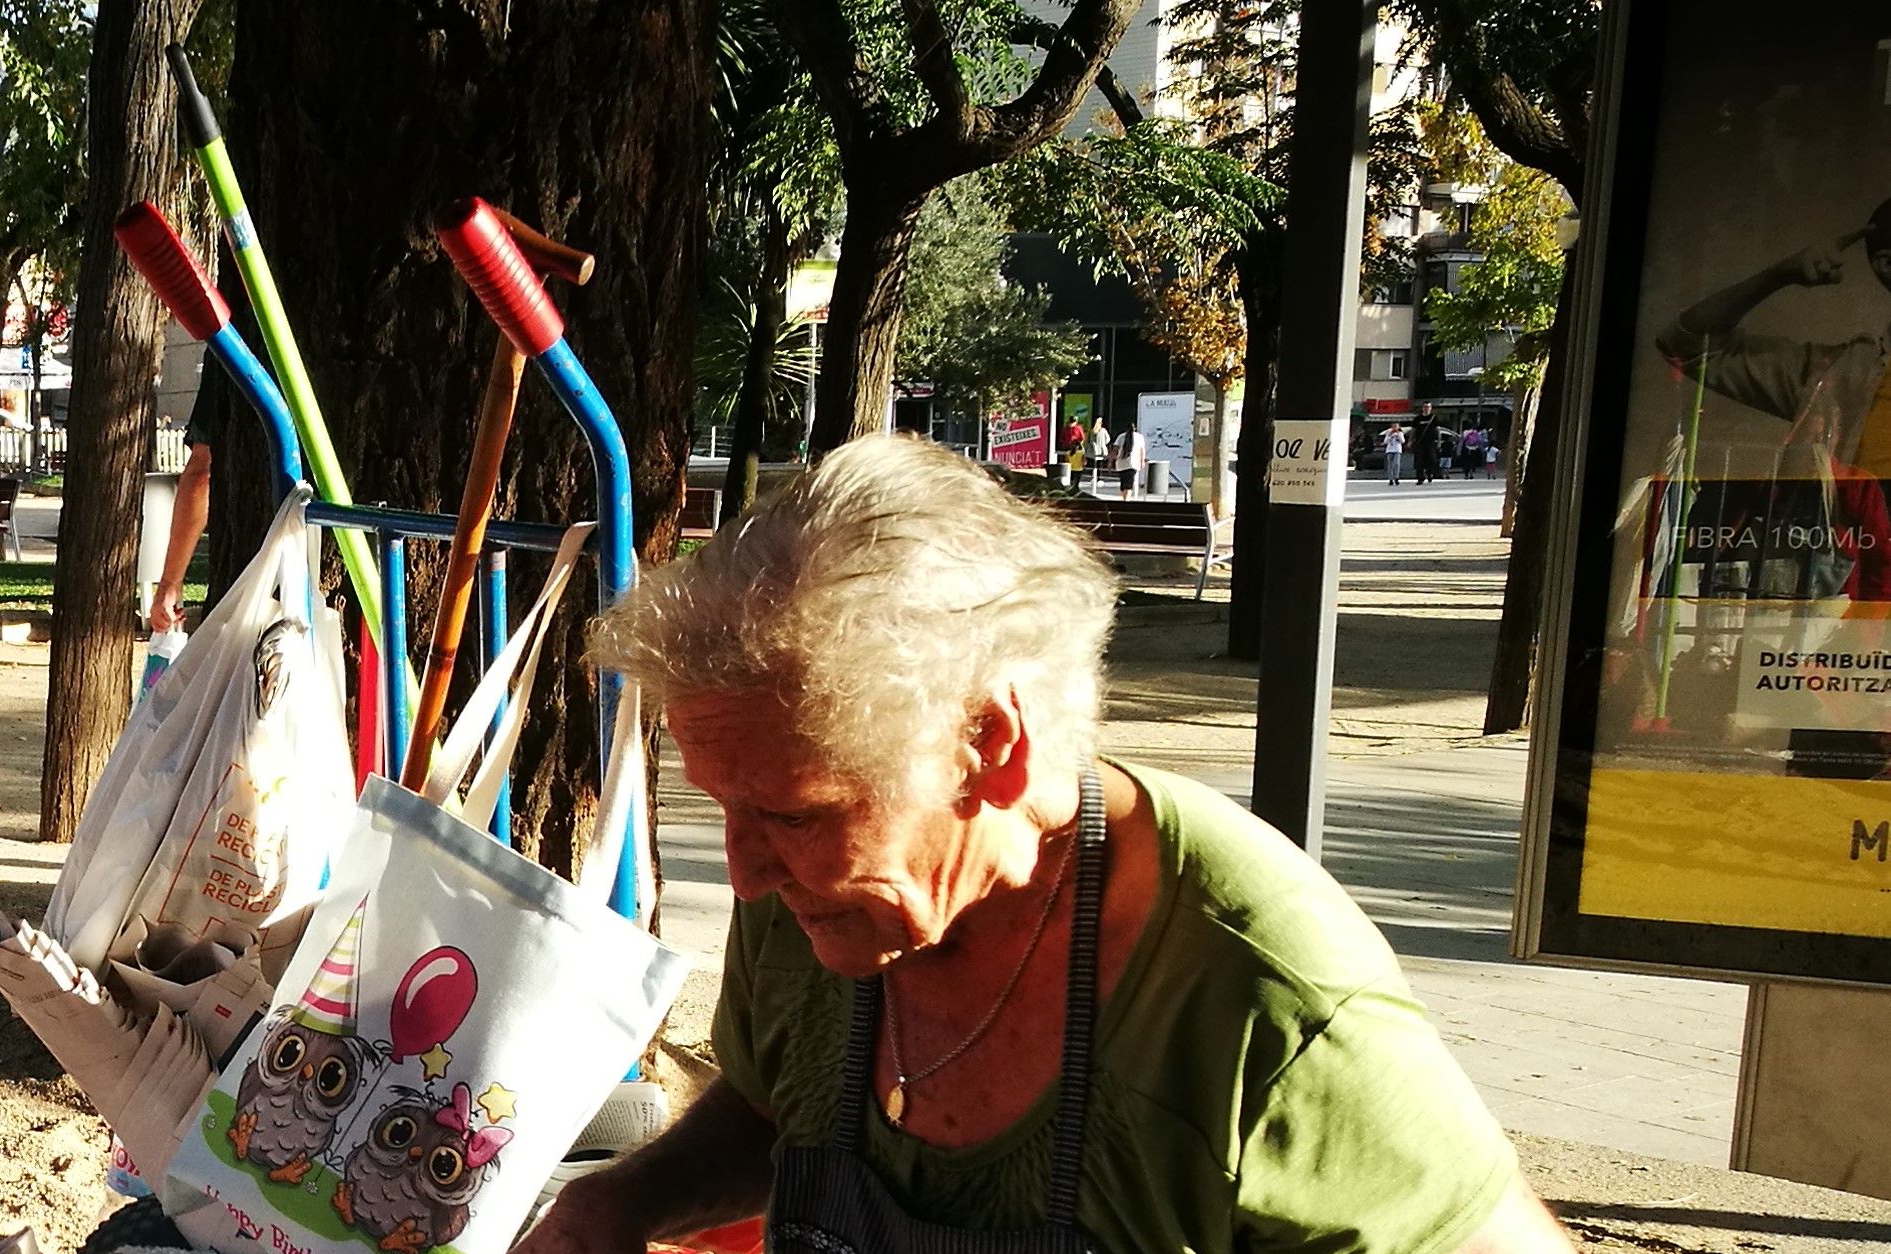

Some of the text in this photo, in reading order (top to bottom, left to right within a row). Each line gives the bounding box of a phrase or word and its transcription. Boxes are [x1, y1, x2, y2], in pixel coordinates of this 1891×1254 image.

[1671, 525, 1876, 550] FIBRA 100Mb
[226, 812, 251, 833] DE
[210, 869, 234, 887] DE
